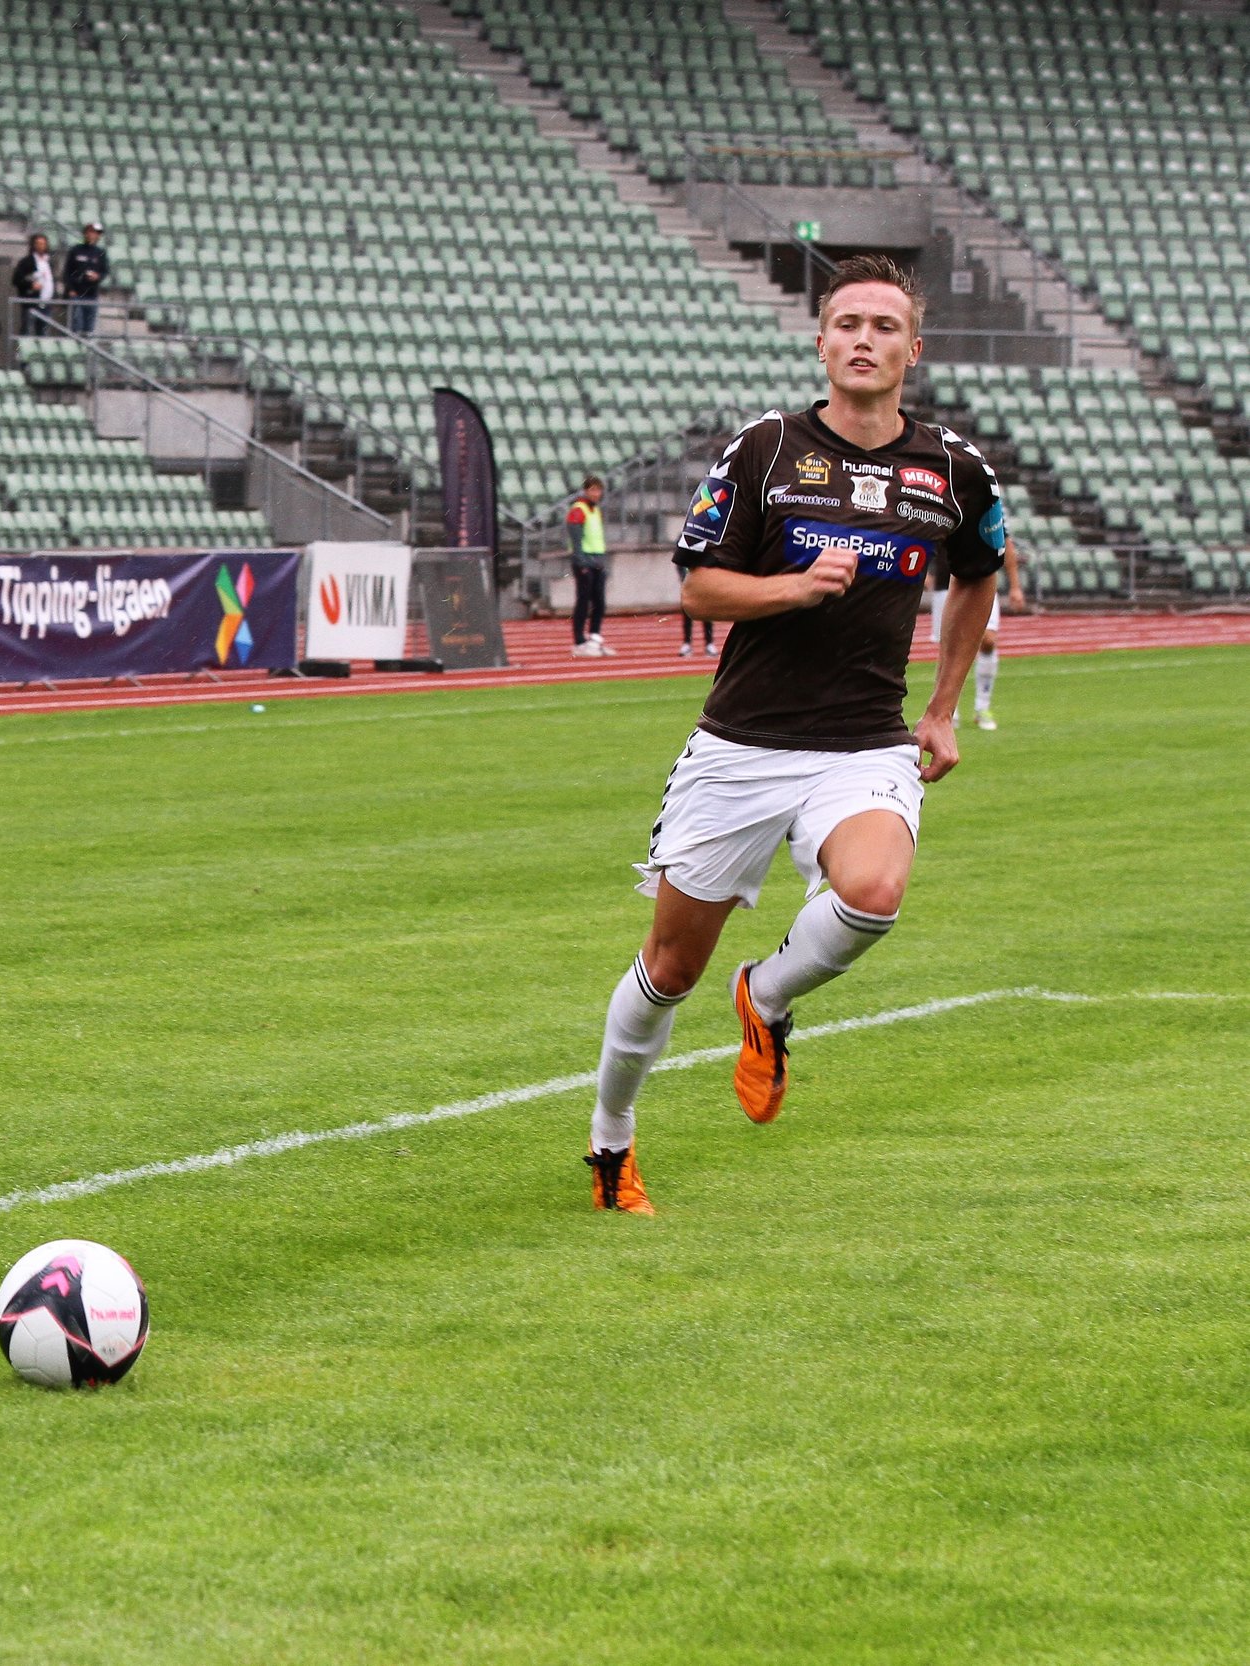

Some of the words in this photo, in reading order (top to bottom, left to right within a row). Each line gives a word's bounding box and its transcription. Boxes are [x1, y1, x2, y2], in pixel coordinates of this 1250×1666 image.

[842, 459, 894, 477] hummel
[904, 472, 942, 489] MENY
[774, 493, 841, 507] Norautron
[901, 486, 944, 504] BORREVEIEN
[792, 527, 897, 560] SpareBank
[908, 551, 920, 571] 1
[877, 561, 893, 571] BV
[345, 574, 397, 627] VISMA
[90, 1306, 136, 1321] hummel
